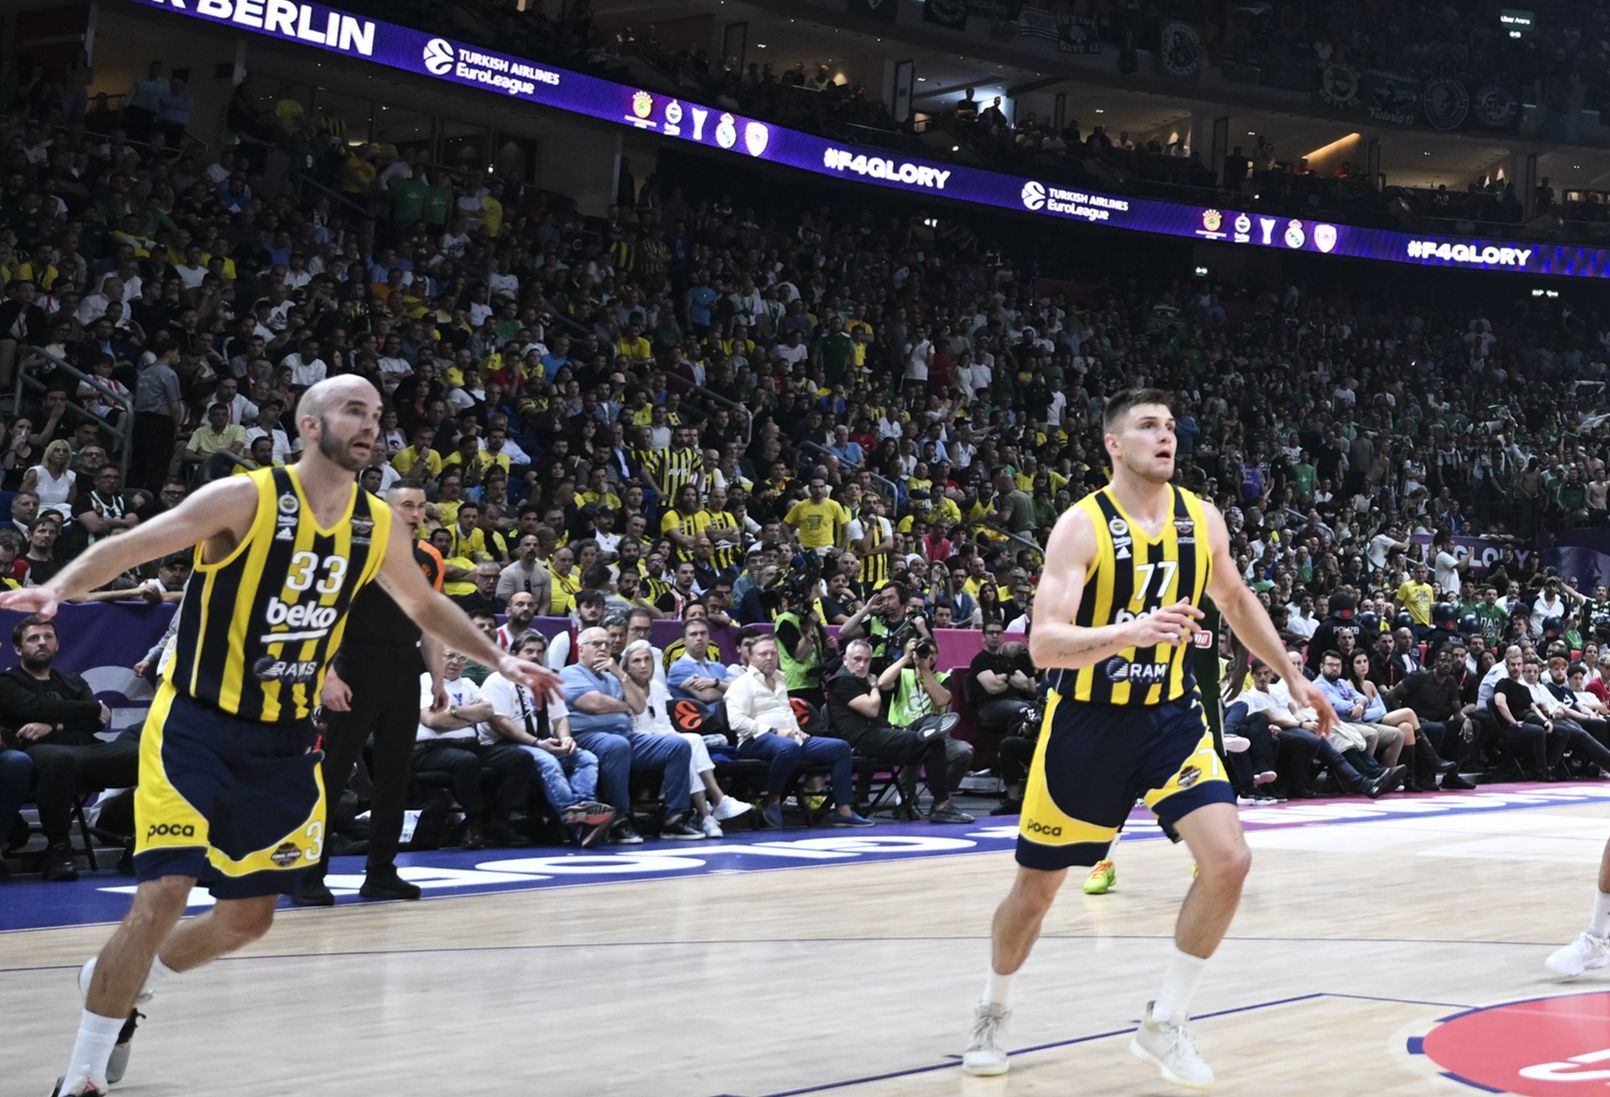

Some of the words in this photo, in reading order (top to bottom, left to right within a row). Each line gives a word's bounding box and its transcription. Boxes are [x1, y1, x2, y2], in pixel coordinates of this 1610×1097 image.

[456, 62, 534, 95] EuroLeague
[459, 49, 509, 75] TURKISH
[510, 62, 560, 86] AIRLINES
[824, 147, 951, 189] #F4GLORY
[1047, 199, 1109, 221] EuroLeague
[1049, 187, 1088, 204] TURKISH
[1089, 195, 1129, 211] AIRLINES
[1407, 240, 1531, 266] #F4GLORY
[286, 551, 348, 595] 33
[1136, 561, 1178, 600] 77
[264, 597, 337, 629] beko
[274, 661, 318, 676] RAMS
[1130, 664, 1169, 678] RAM
[147, 822, 195, 843] poca
